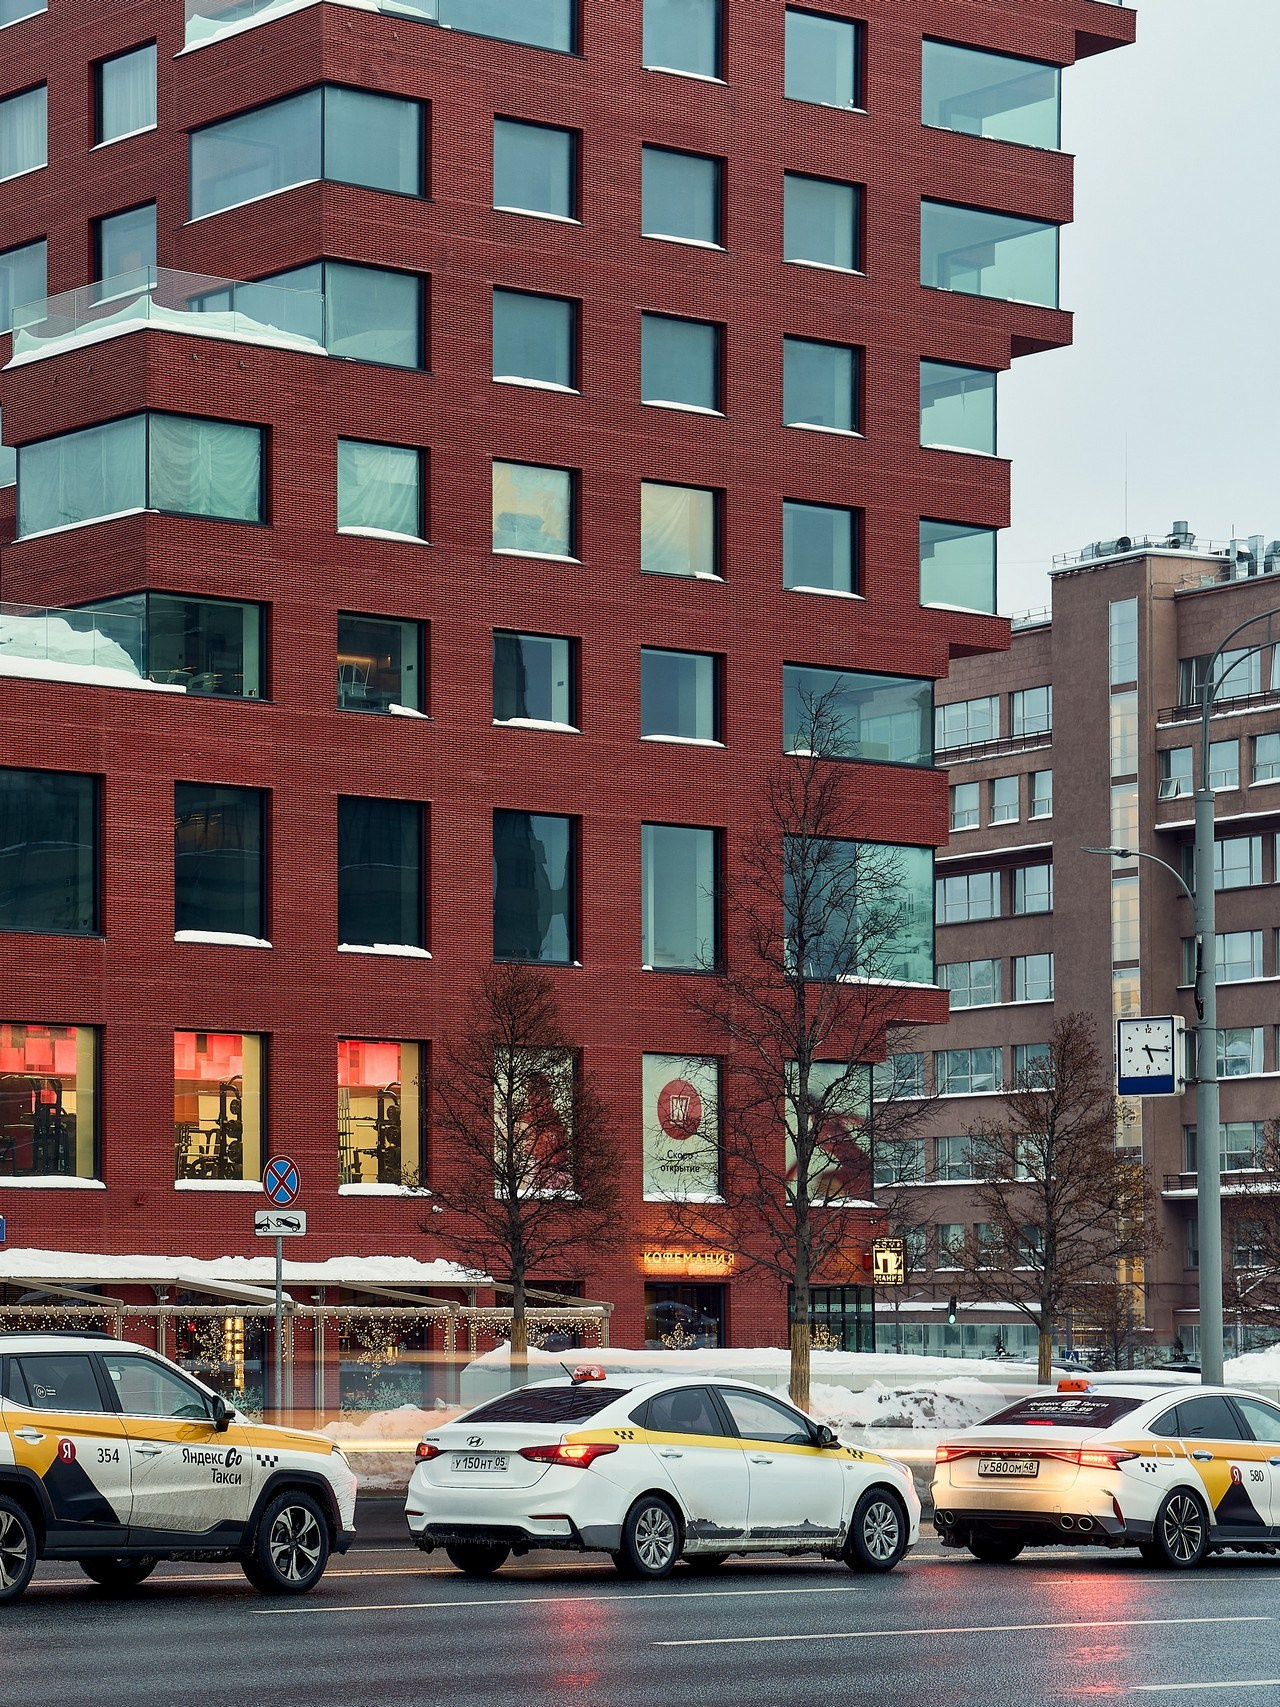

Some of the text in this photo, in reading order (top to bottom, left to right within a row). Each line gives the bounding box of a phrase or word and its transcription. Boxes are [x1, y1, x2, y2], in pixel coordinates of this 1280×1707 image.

[667, 1150, 694, 1161] Скоро
[661, 1165, 701, 1174] открытие
[643, 1251, 735, 1265] КОФЕМАНИЯ
[62, 1442, 71, 1459] Я
[97, 1448, 120, 1463] 354
[182, 1447, 243, 1468] Яндекс Go
[494, 1457, 505, 1467] 05
[982, 1462, 1034, 1473] У580ОМ 48
[211, 1468, 242, 1485] Такси
[1233, 1469, 1240, 1482] Я
[1249, 1469, 1265, 1482] 580
